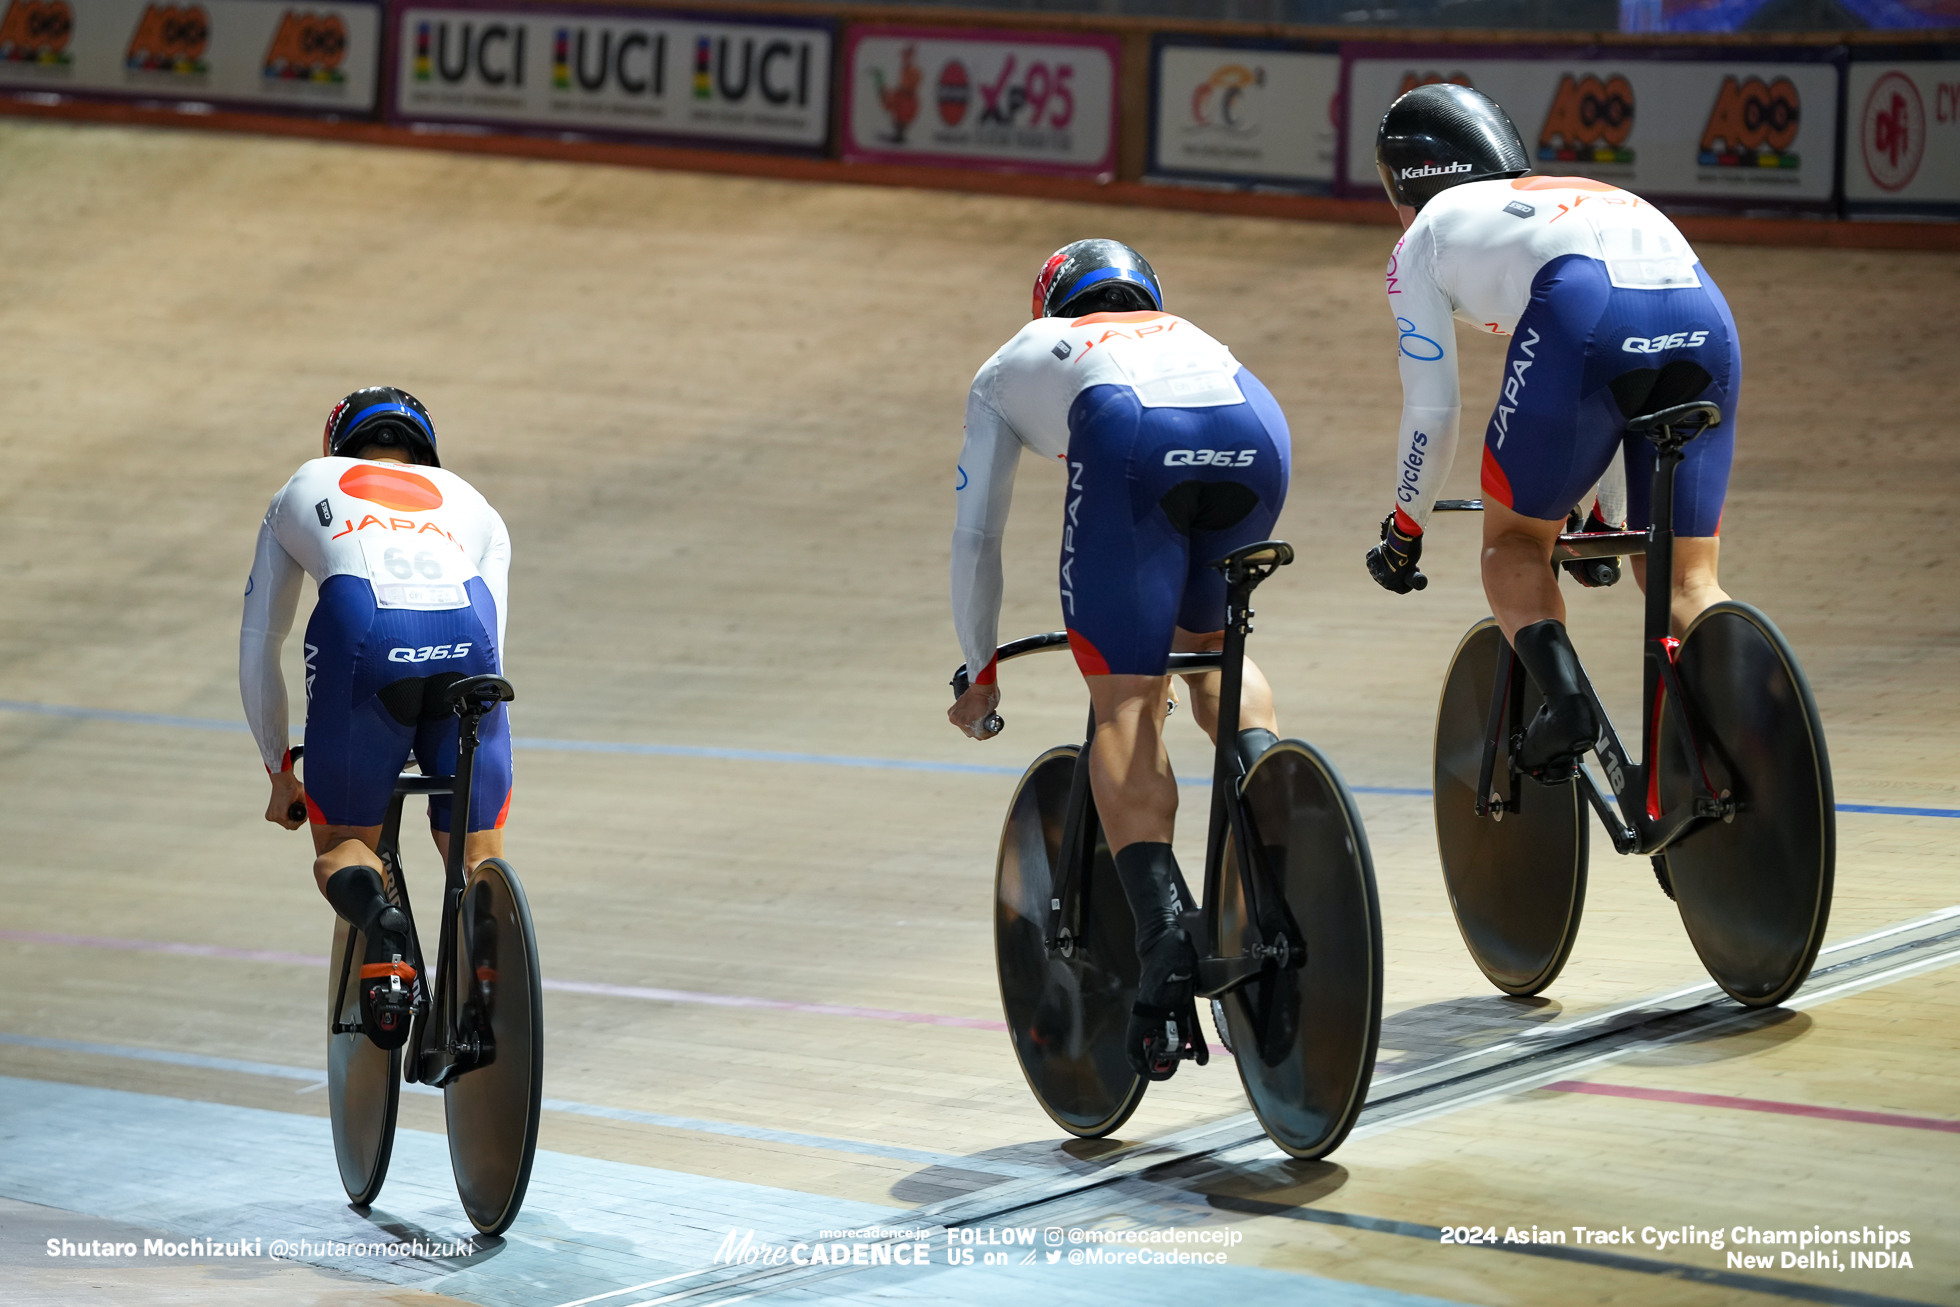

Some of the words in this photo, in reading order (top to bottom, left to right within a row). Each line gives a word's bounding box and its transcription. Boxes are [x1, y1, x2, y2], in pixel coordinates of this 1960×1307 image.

[438, 22, 527, 88] UCI
[576, 28, 668, 96] UCI
[718, 36, 811, 108] UCI
[1401, 161, 1473, 180] Kabuto
[1621, 330, 1709, 354] Q36.5
[1493, 327, 1541, 450] JAPAN
[1163, 449, 1258, 467] Q36.5
[1397, 430, 1428, 503] Cyclers
[383, 547, 443, 581] 66
[1061, 461, 1084, 617] JAPAN
[387, 642, 473, 663] Q36.5
